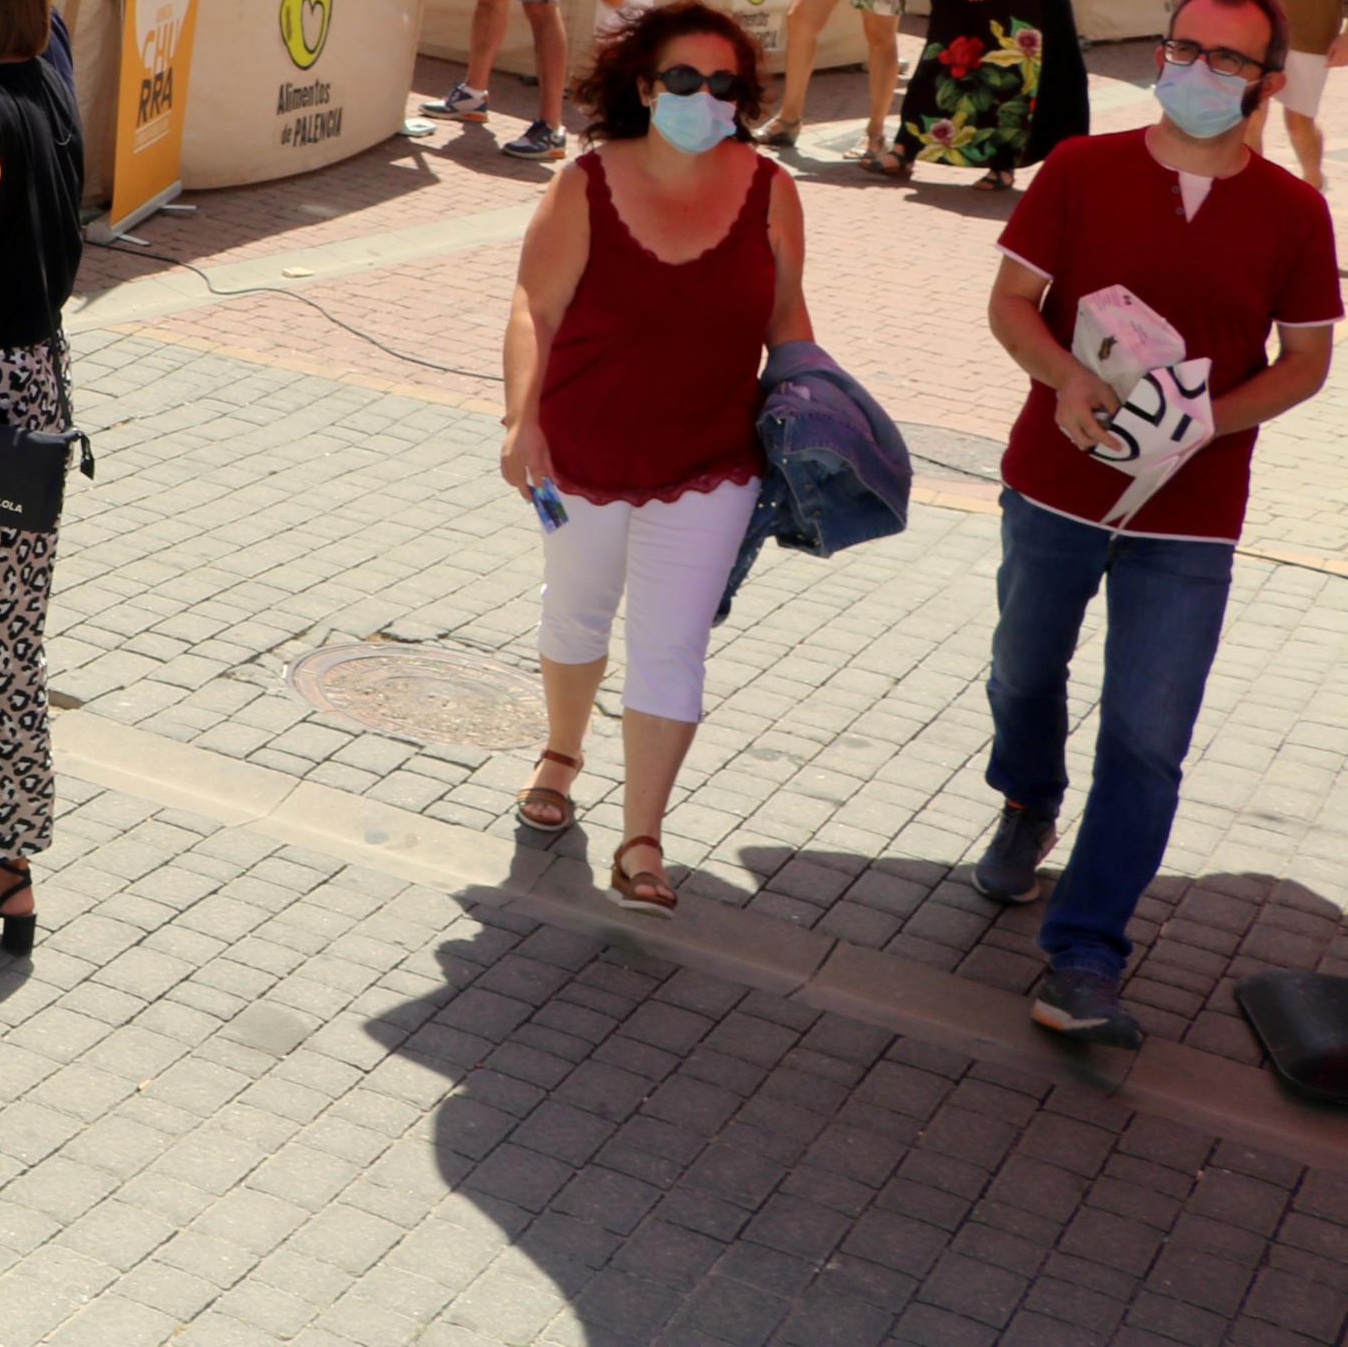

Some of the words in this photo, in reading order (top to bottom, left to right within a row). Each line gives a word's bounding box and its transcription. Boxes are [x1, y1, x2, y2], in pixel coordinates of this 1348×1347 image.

[137, 66, 173, 130] RRA
[276, 78, 331, 115] Alimentos
[281, 124, 293, 146] de
[292, 106, 343, 148] PALENCIA
